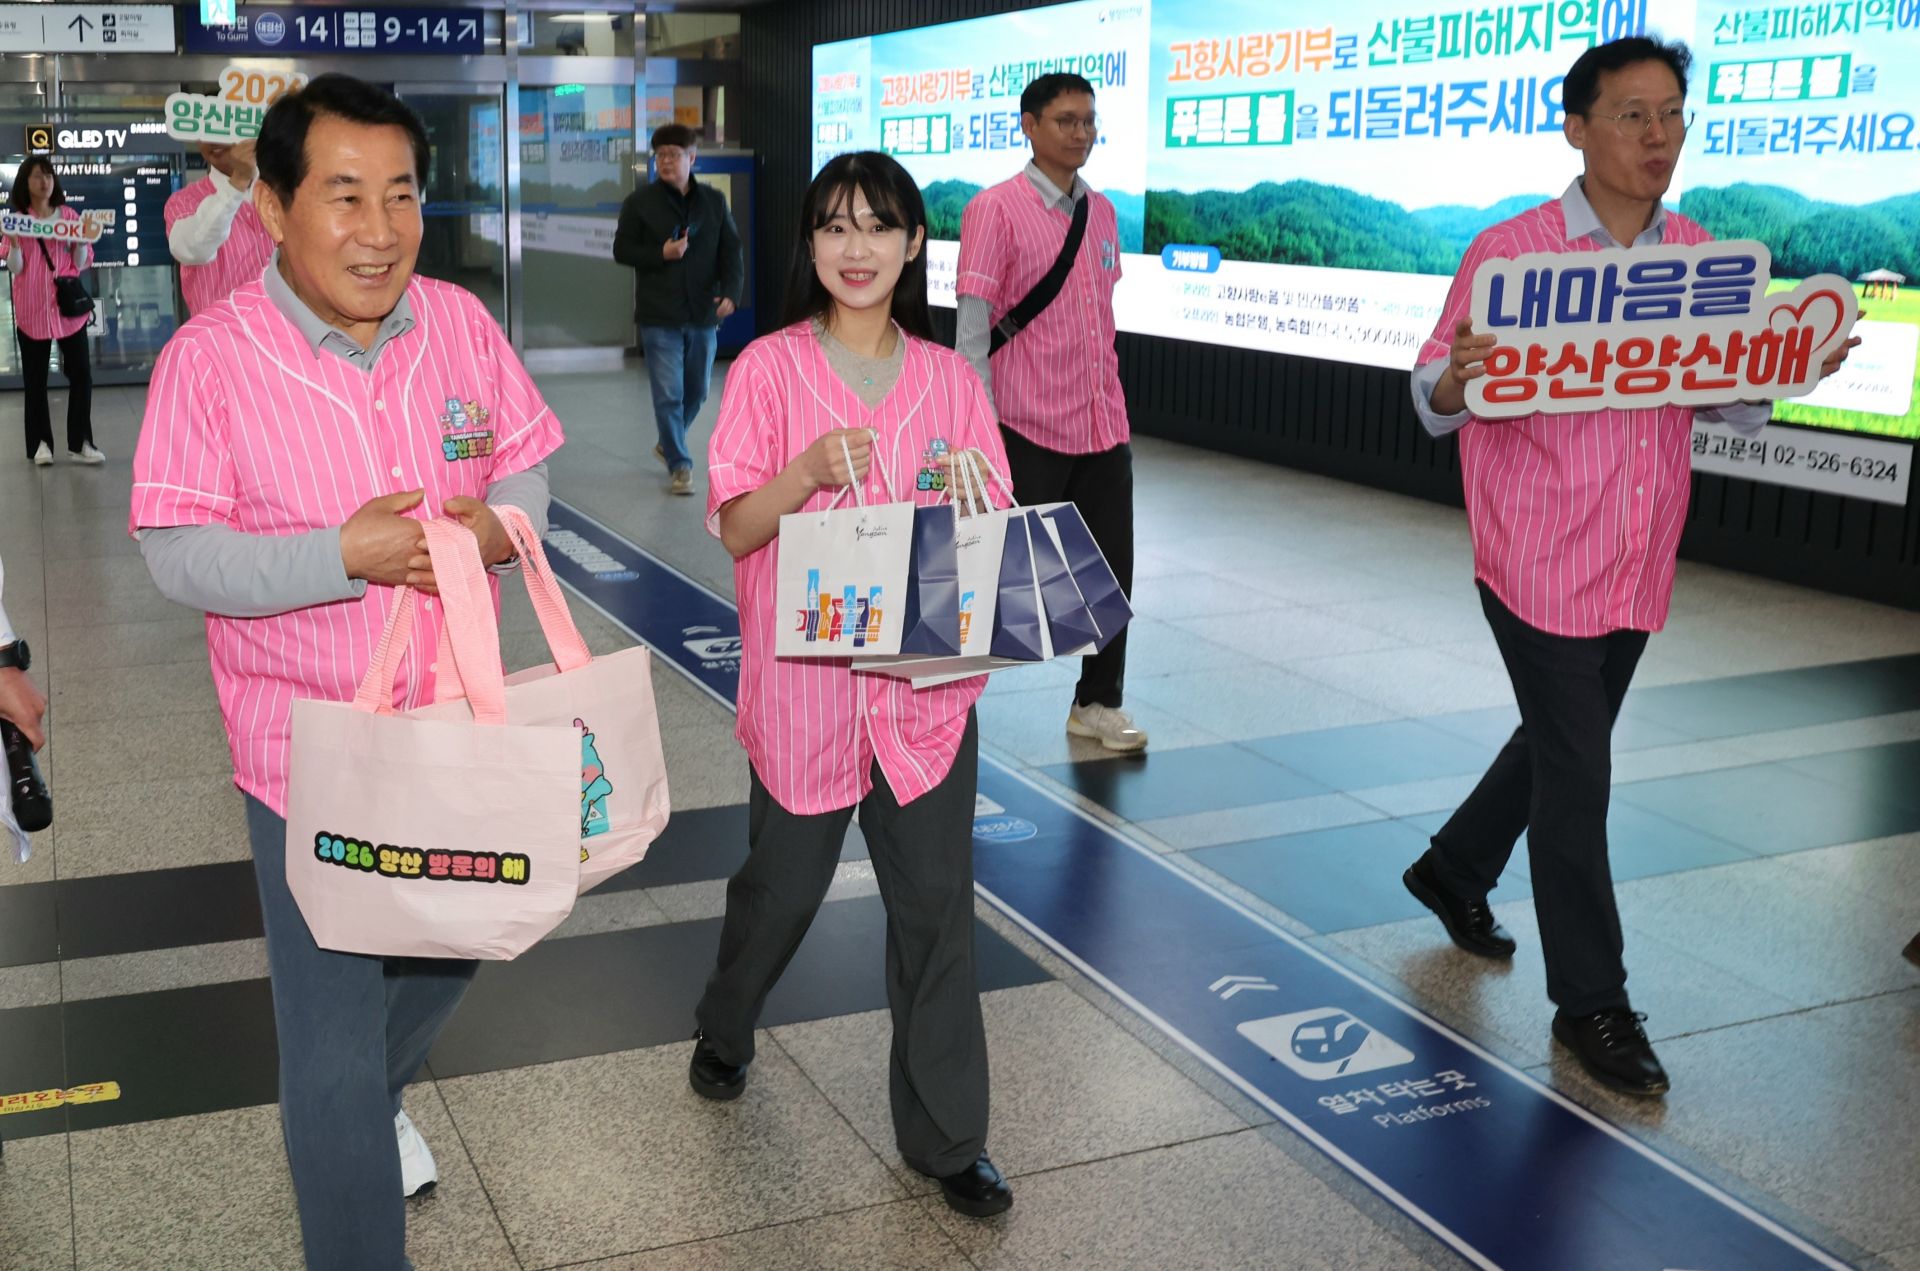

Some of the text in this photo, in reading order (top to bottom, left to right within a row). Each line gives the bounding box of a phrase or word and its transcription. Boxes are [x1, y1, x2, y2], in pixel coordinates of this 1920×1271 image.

[216, 31, 248, 41] To Gumi
[257, 21, 283, 33] 대경선
[296, 16, 328, 43] 14
[383, 17, 450, 43] 9-14
[1168, 27, 1358, 81] 고향사랑기부로
[880, 68, 984, 107] 고향사랑기부로
[130, 123, 167, 134] SAMSUN
[172, 99, 264, 138] 양산방
[57, 129, 127, 149] QLED TV
[1487, 254, 1757, 329] 내마음을
[1692, 431, 1899, 483] 광고문의 02-526-6324
[318, 836, 525, 881] 2026 양산 방문의 해
[0, 1091, 75, 1106] 려오는
[1317, 1086, 1388, 1116] 열차
[1372, 1095, 1492, 1129] Platforms
